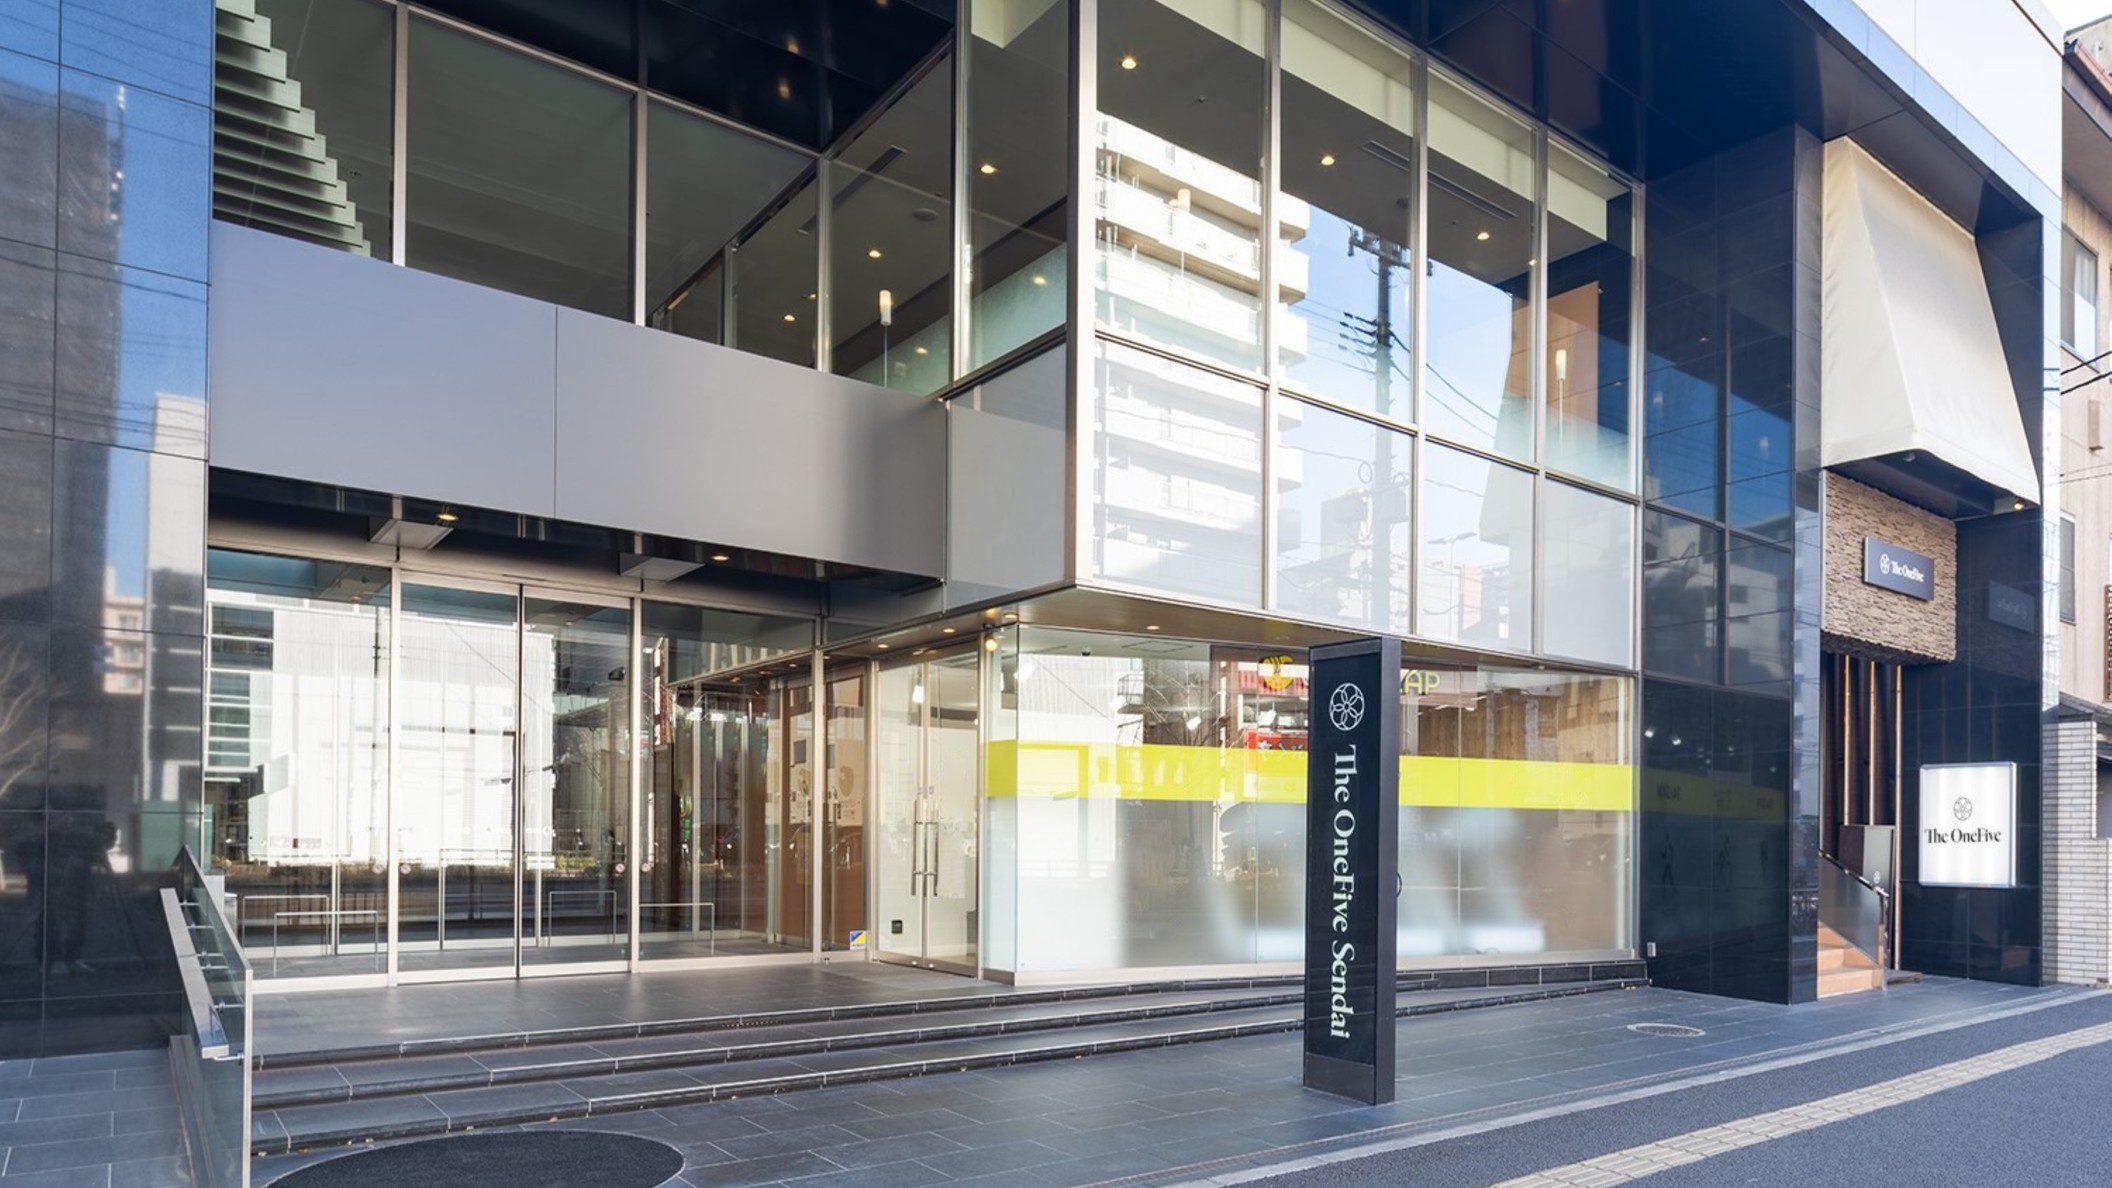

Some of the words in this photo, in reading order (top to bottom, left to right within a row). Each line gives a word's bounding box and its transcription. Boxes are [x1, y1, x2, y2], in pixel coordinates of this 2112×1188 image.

[1400, 669, 1441, 695] AP
[1335, 744, 1357, 803] The
[1924, 828, 1949, 844] The
[1950, 827, 2002, 843] OneFive
[1332, 809, 1355, 933] OneFive
[1330, 940, 1355, 1038] Sendai
